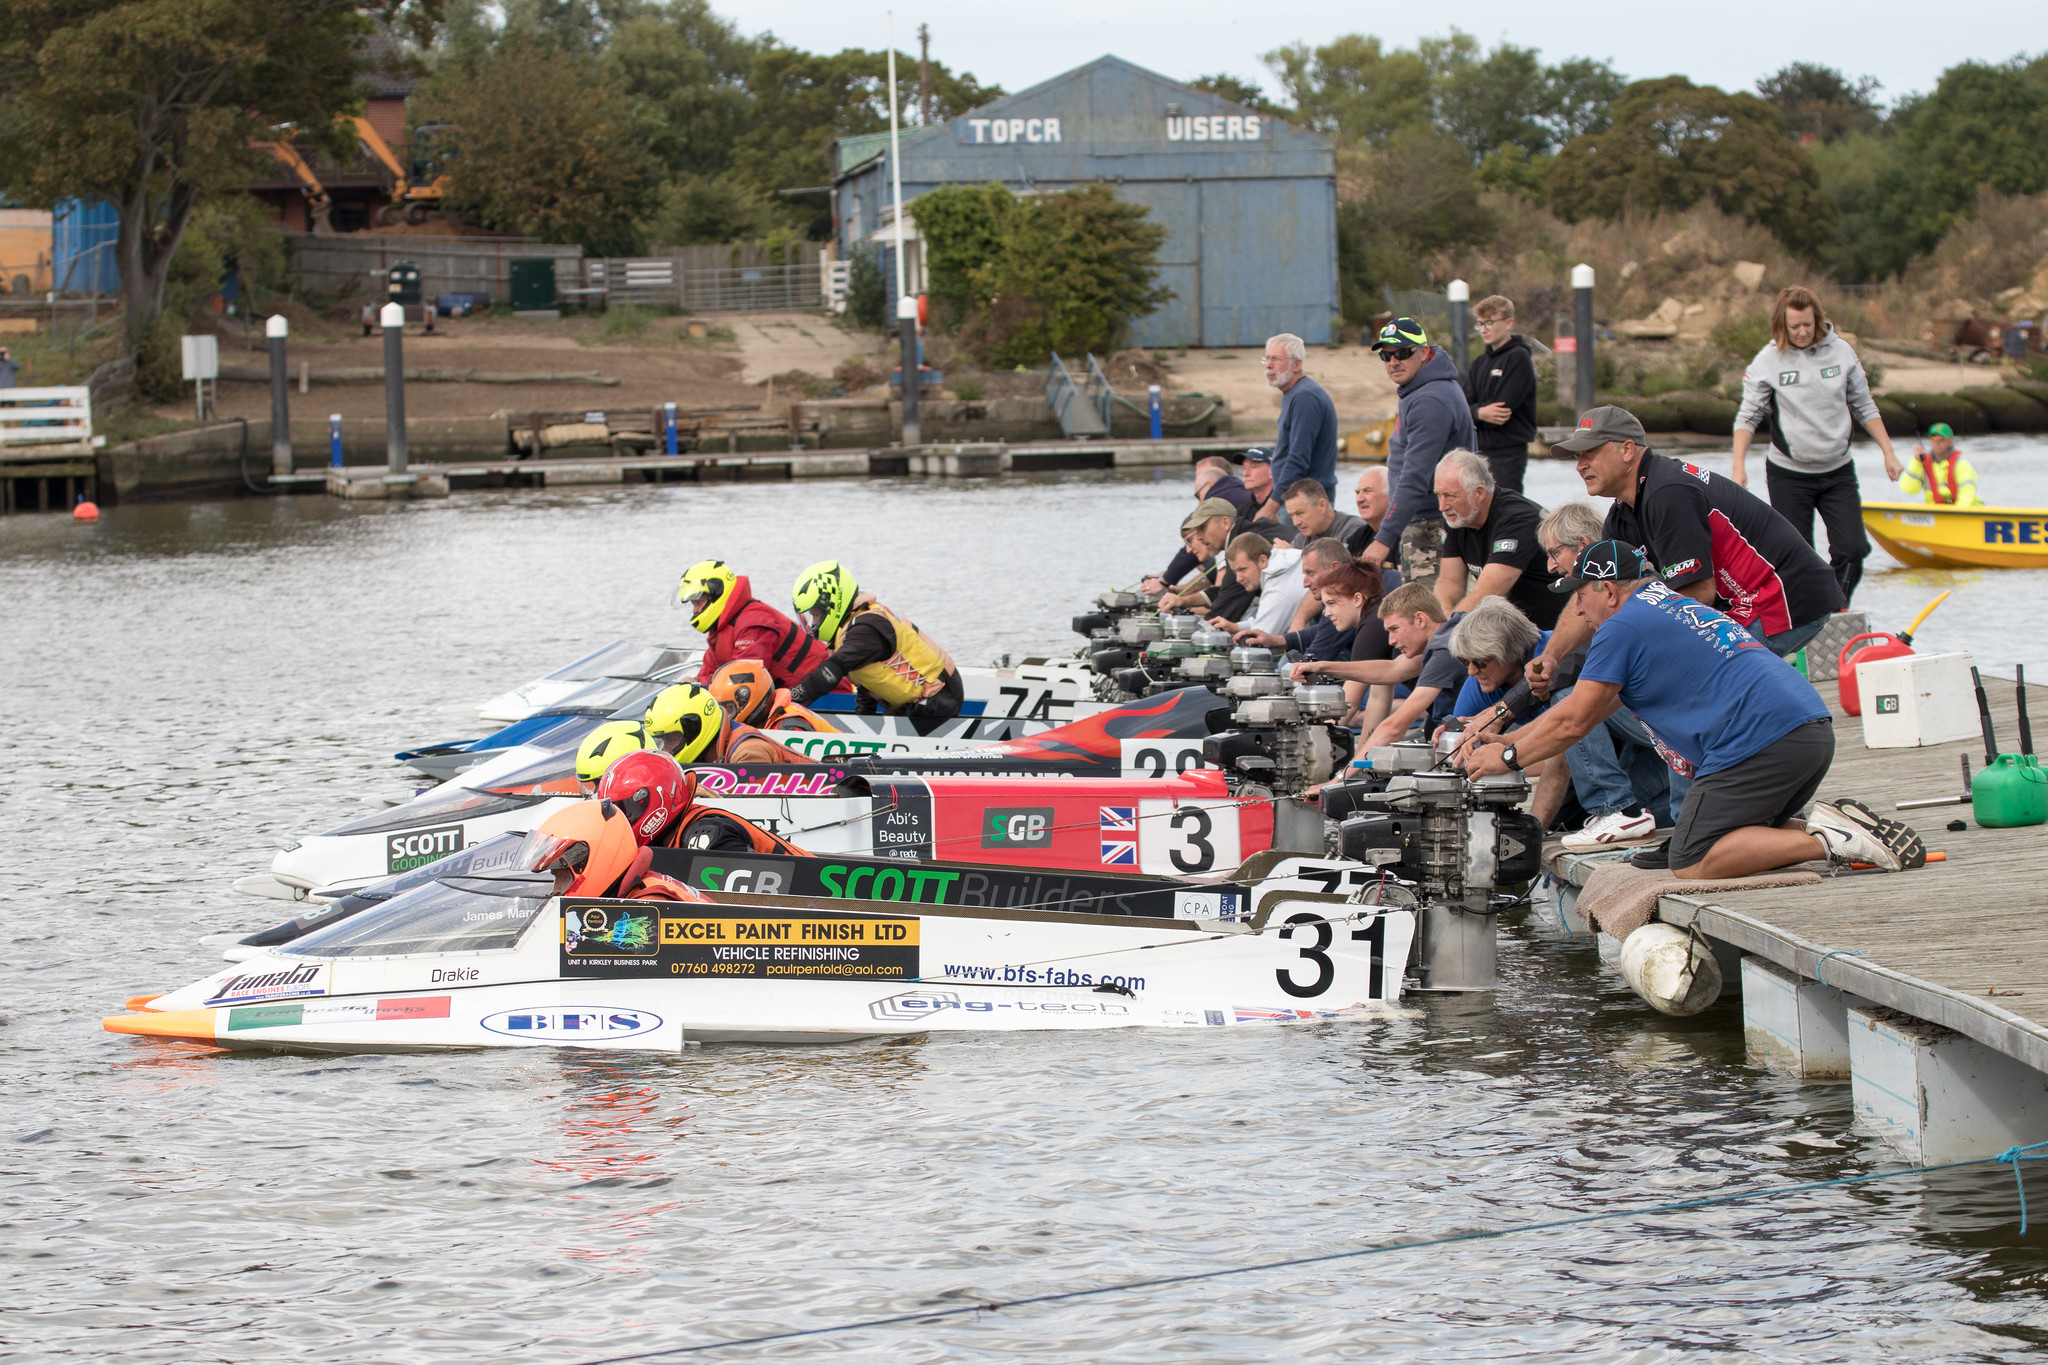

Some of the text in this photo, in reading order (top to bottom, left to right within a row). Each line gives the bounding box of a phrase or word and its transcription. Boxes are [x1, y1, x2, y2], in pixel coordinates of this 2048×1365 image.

[969, 118, 1061, 143] TOPCR
[1781, 372, 1797, 385] 77
[1984, 521, 2048, 544] RE
[1495, 541, 1516, 551] SGB
[1877, 697, 1898, 712] SGB
[641, 811, 666, 834] BELL
[887, 812, 919, 825] Abi's
[990, 814, 1046, 842] SGB
[391, 829, 460, 859] SCOTT
[879, 830, 926, 846] Beauty
[1169, 805, 1216, 873] 3
[391, 851, 456, 872] GOODIN
[700, 866, 783, 894] SGB
[818, 864, 961, 903] SCOTT
[463, 911, 503, 922] James
[1183, 902, 1210, 915] CPA
[664, 922, 907, 940] EXCEL PAINT FINISH LTD
[712, 947, 860, 961] VEHICLE REFINISHING
[1276, 912, 1386, 999] 31
[431, 966, 480, 983] Drakie
[671, 963, 903, 976] 07760 498272 paulrpenfold@aol.com
[230, 984, 311, 998] RACE ENGINES EUROPE
[901, 1000, 1129, 1013] eng-tech
